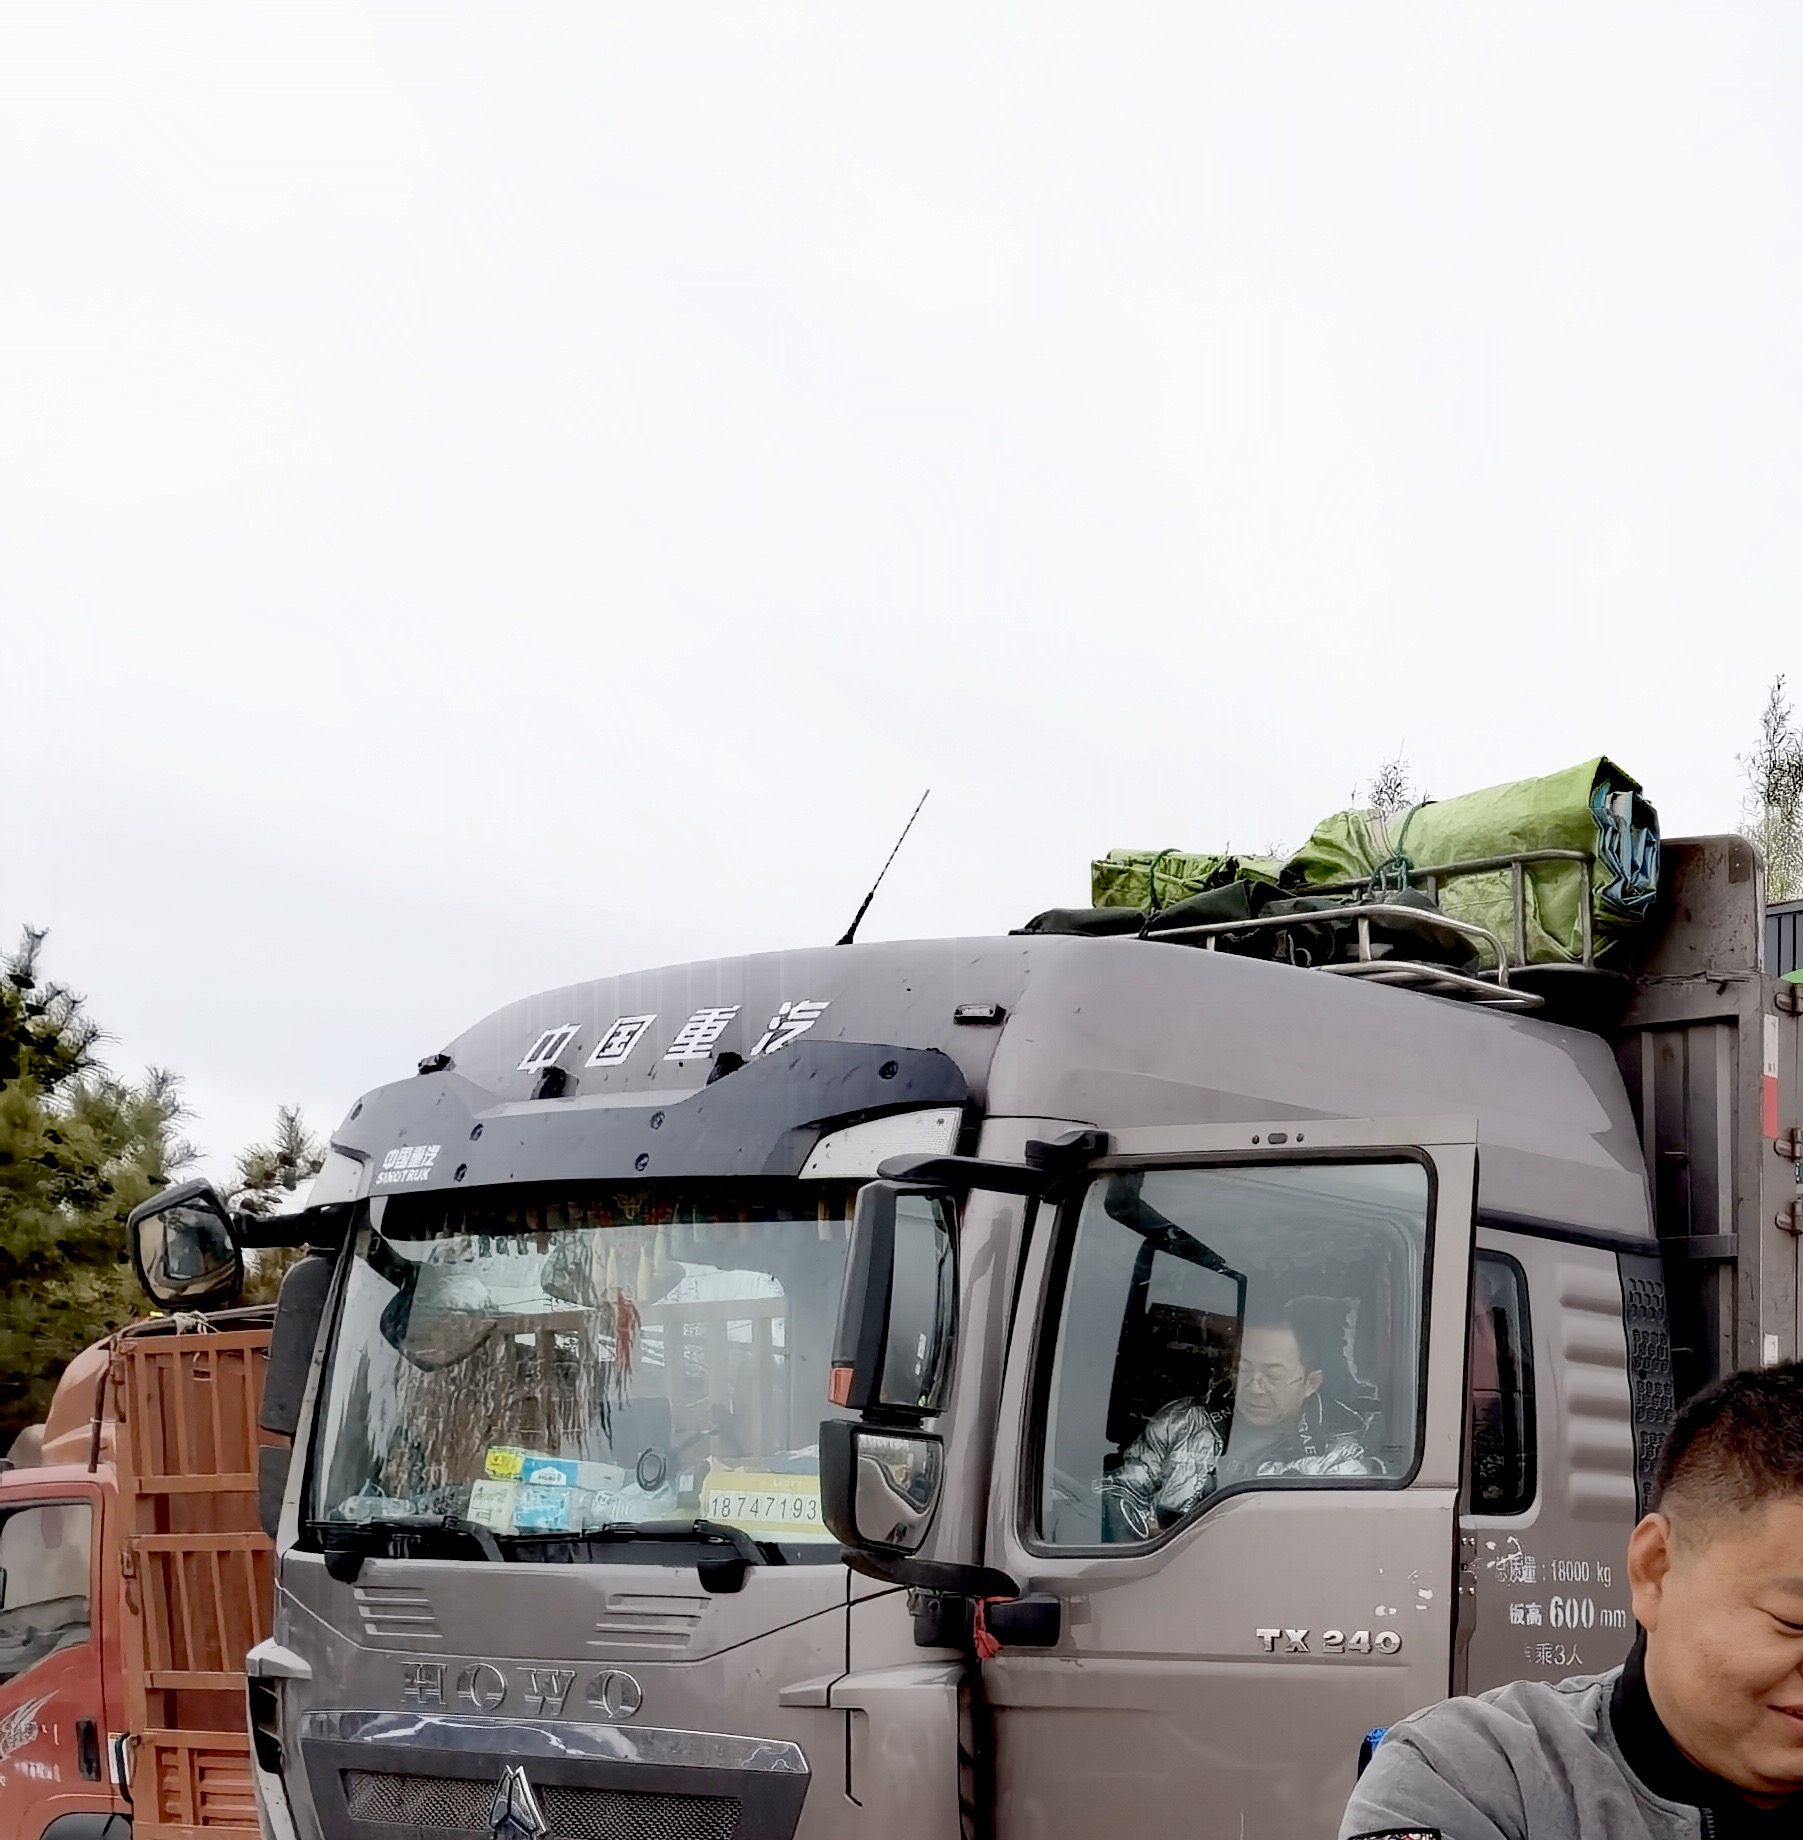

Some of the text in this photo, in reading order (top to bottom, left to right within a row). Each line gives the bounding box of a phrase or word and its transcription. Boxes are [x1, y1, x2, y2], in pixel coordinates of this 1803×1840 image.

[517, 1000, 830, 1073] 中国重汽
[1551, 1560, 1590, 1582] 18000
[1597, 1562, 1612, 1587] kg
[1509, 1596, 1626, 1629] 板高 600 mm
[1256, 1628, 1402, 1655] TX 240
[399, 1661, 644, 1720] HOWO
